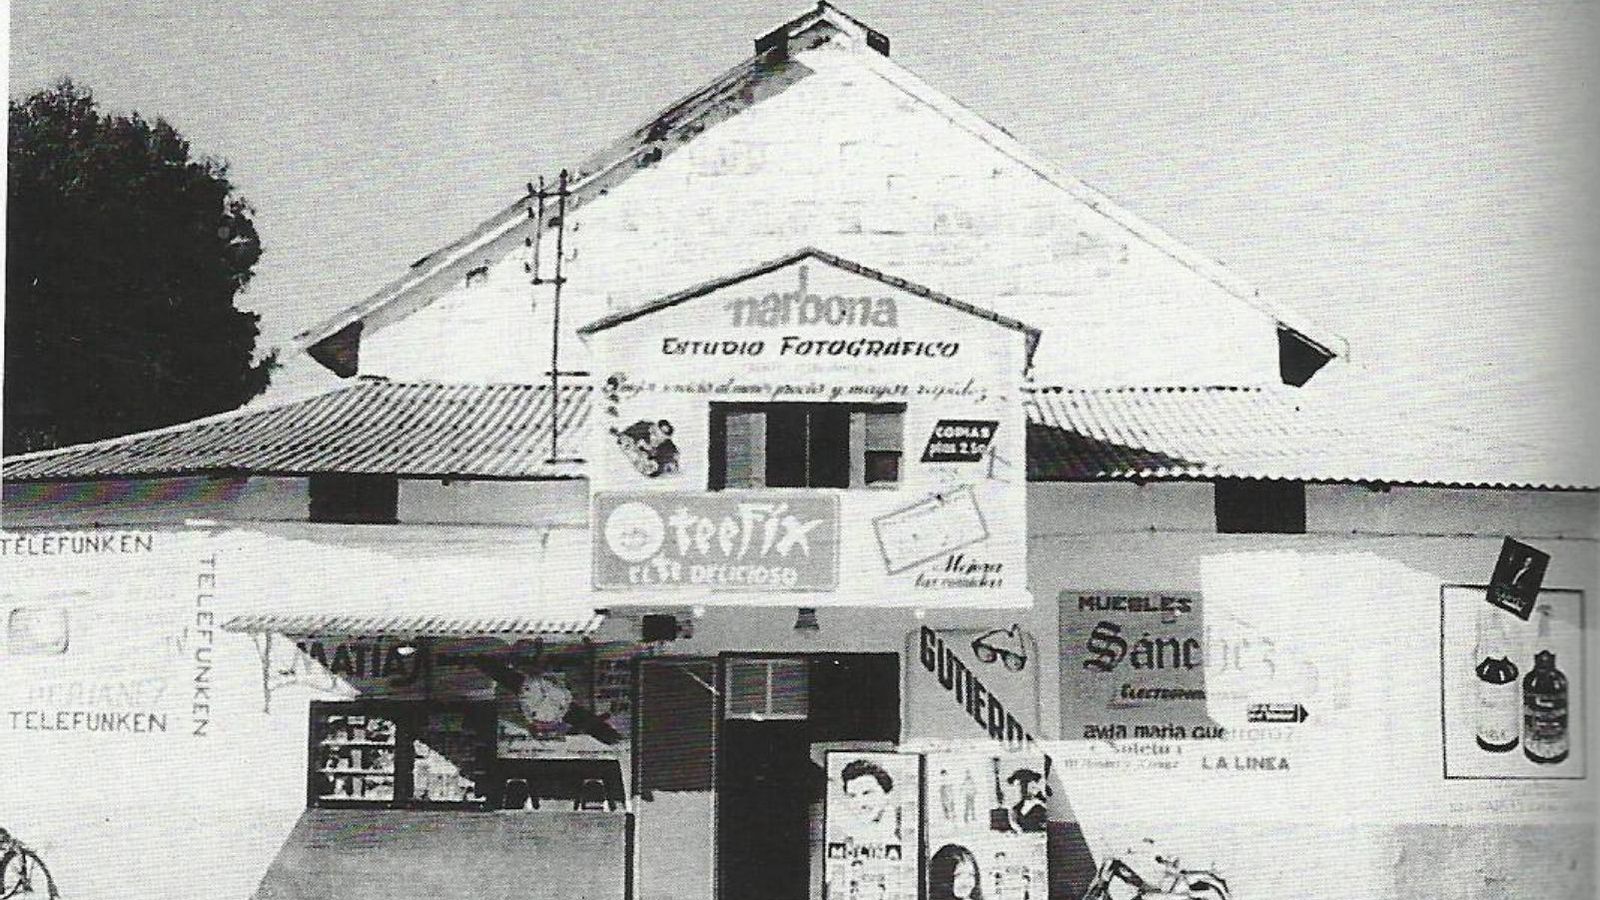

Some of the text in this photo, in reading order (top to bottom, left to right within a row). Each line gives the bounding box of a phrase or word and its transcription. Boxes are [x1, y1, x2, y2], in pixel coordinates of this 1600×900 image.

[724, 266, 898, 328] narbona
[935, 426, 991, 438] COPIAS
[2, 535, 153, 555] TELEFUNKEN
[1079, 595, 1192, 612] MUEBLES
[192, 553, 216, 737] TELEFUNKEN
[9, 711, 168, 732] TELEFUNKEN
